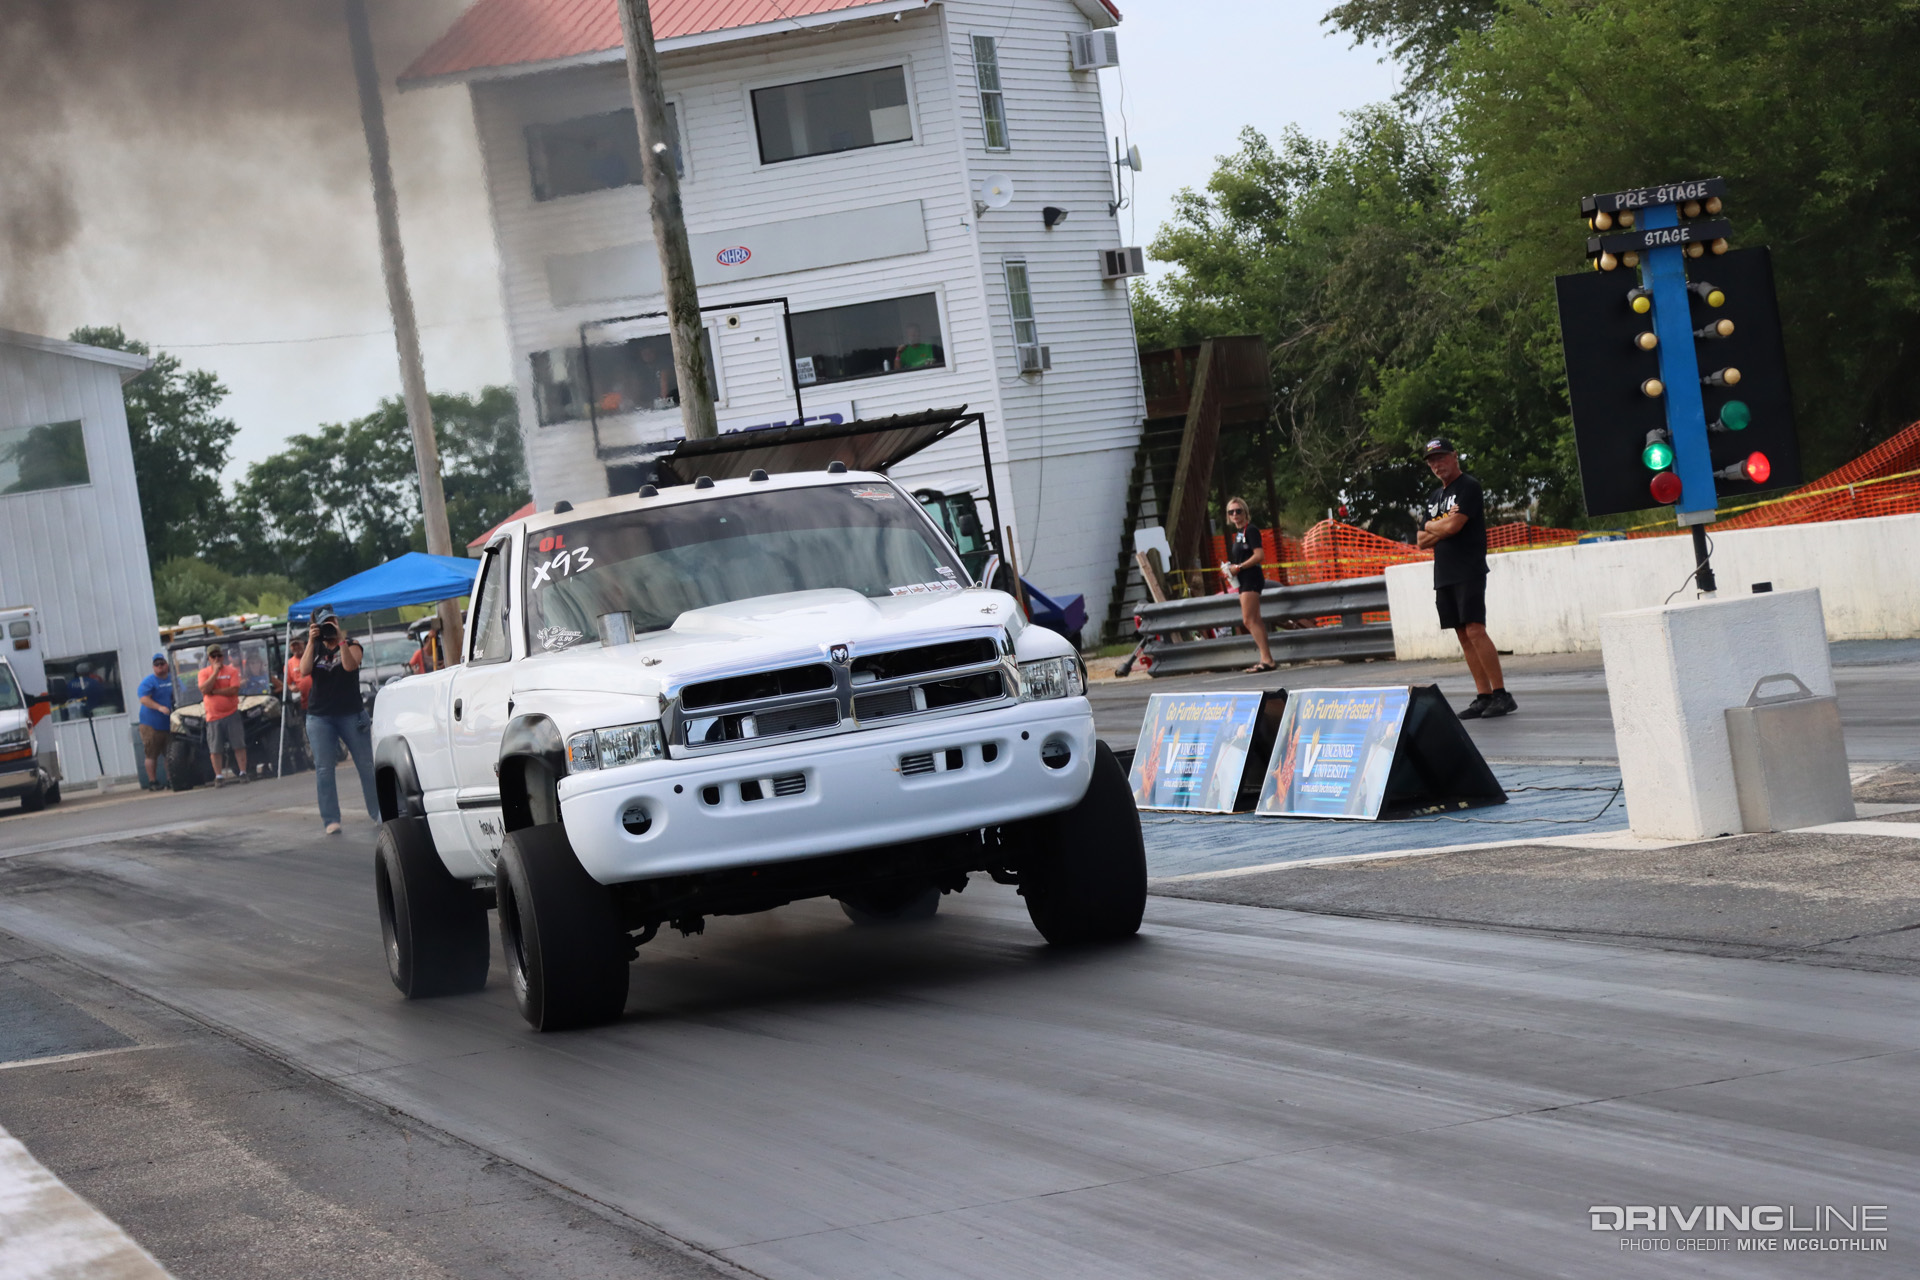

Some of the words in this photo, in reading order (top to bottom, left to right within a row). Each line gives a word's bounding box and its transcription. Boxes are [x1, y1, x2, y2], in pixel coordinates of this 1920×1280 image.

[1615, 182, 1708, 209] PRE-STAGE
[1644, 227, 1690, 246] STAGE
[721, 248, 747, 264] NHRA
[539, 535, 567, 552] OL
[1302, 698, 1315, 720] Go
[1313, 698, 1347, 720] Further
[1345, 698, 1377, 720] Faster!
[1321, 744, 1355, 758] VINCENNES
[1313, 764, 1351, 779] UNIVERSITY
